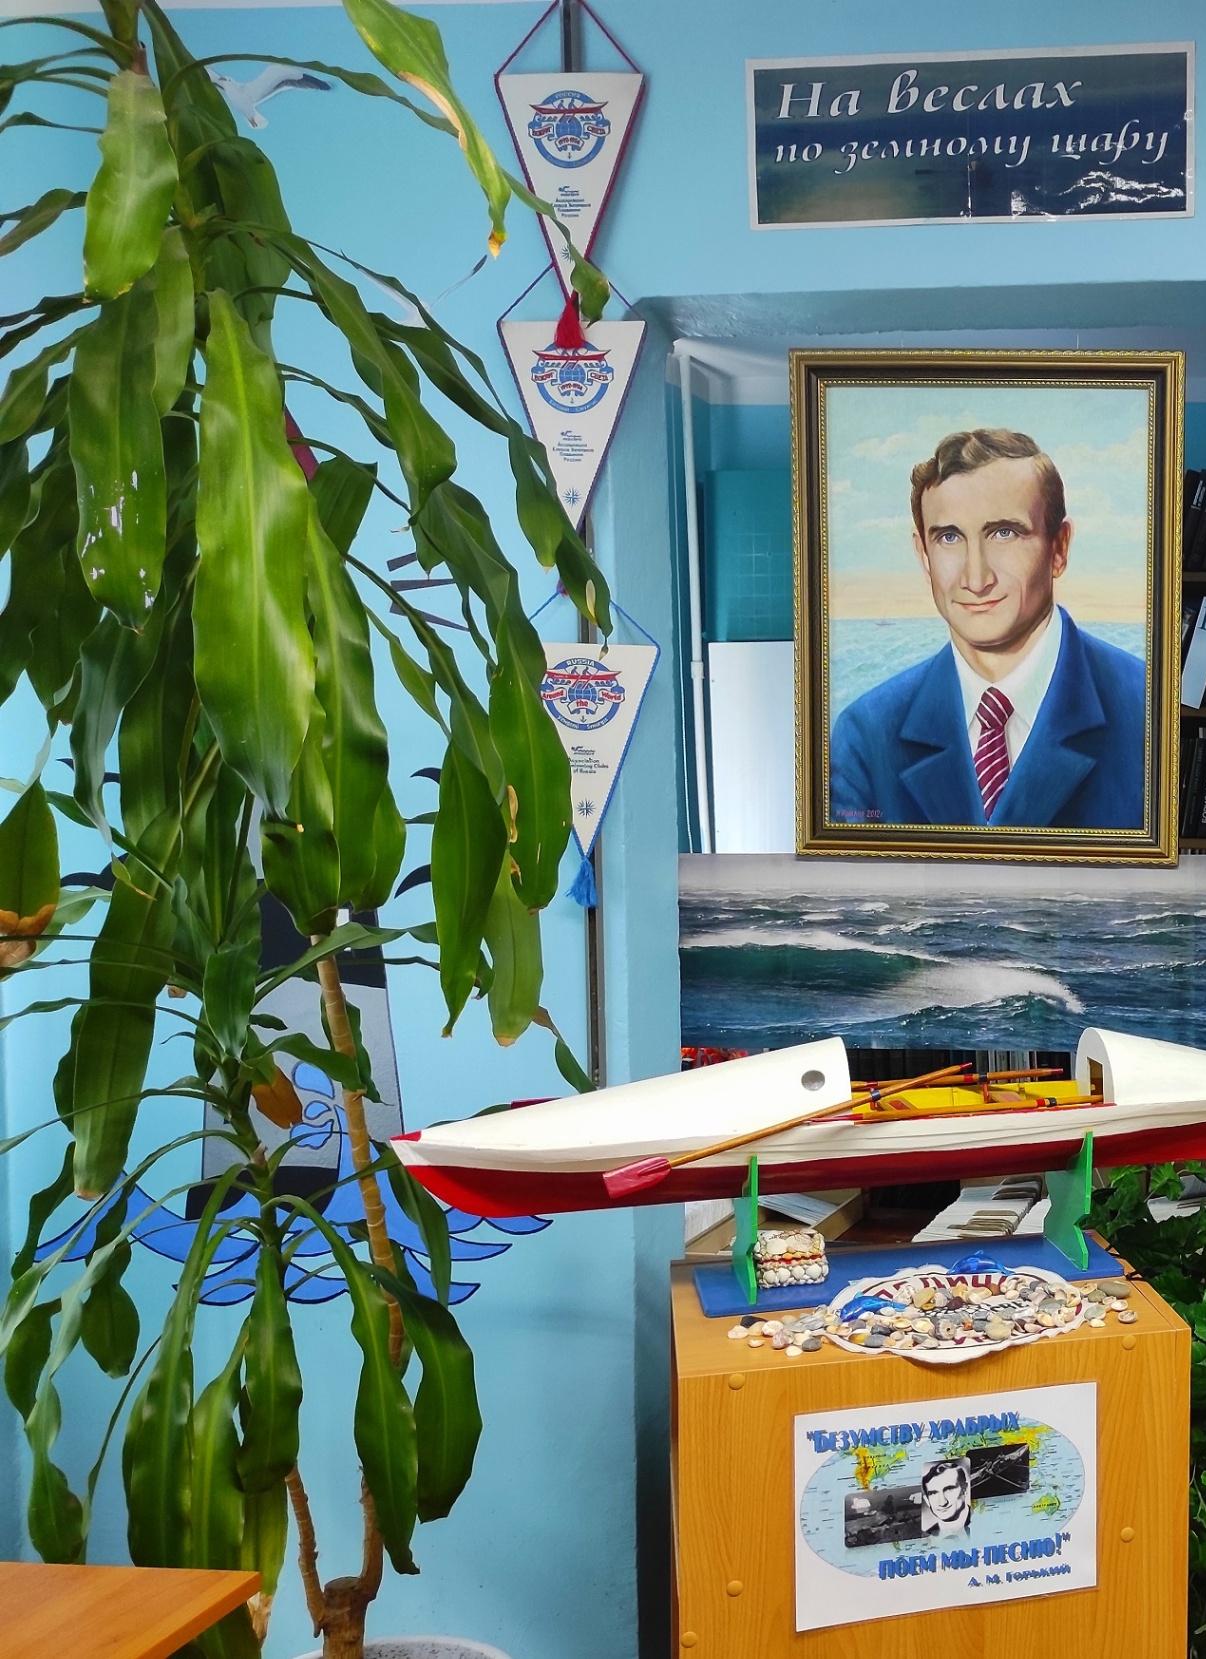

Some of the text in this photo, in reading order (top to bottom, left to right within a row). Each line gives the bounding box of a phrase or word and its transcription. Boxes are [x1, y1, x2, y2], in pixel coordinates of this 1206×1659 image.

[776, 69, 1082, 120] На веслах
[774, 119, 1168, 174] по земному шару
[807, 1410, 1021, 1453] "БЕЗУМСТВУ ХРАБРЫХ
[879, 1552, 937, 1580] ПОЕМ
[941, 1547, 980, 1570] МЫ
[967, 1576, 982, 1588] А.
[986, 1573, 1004, 1585] М.
